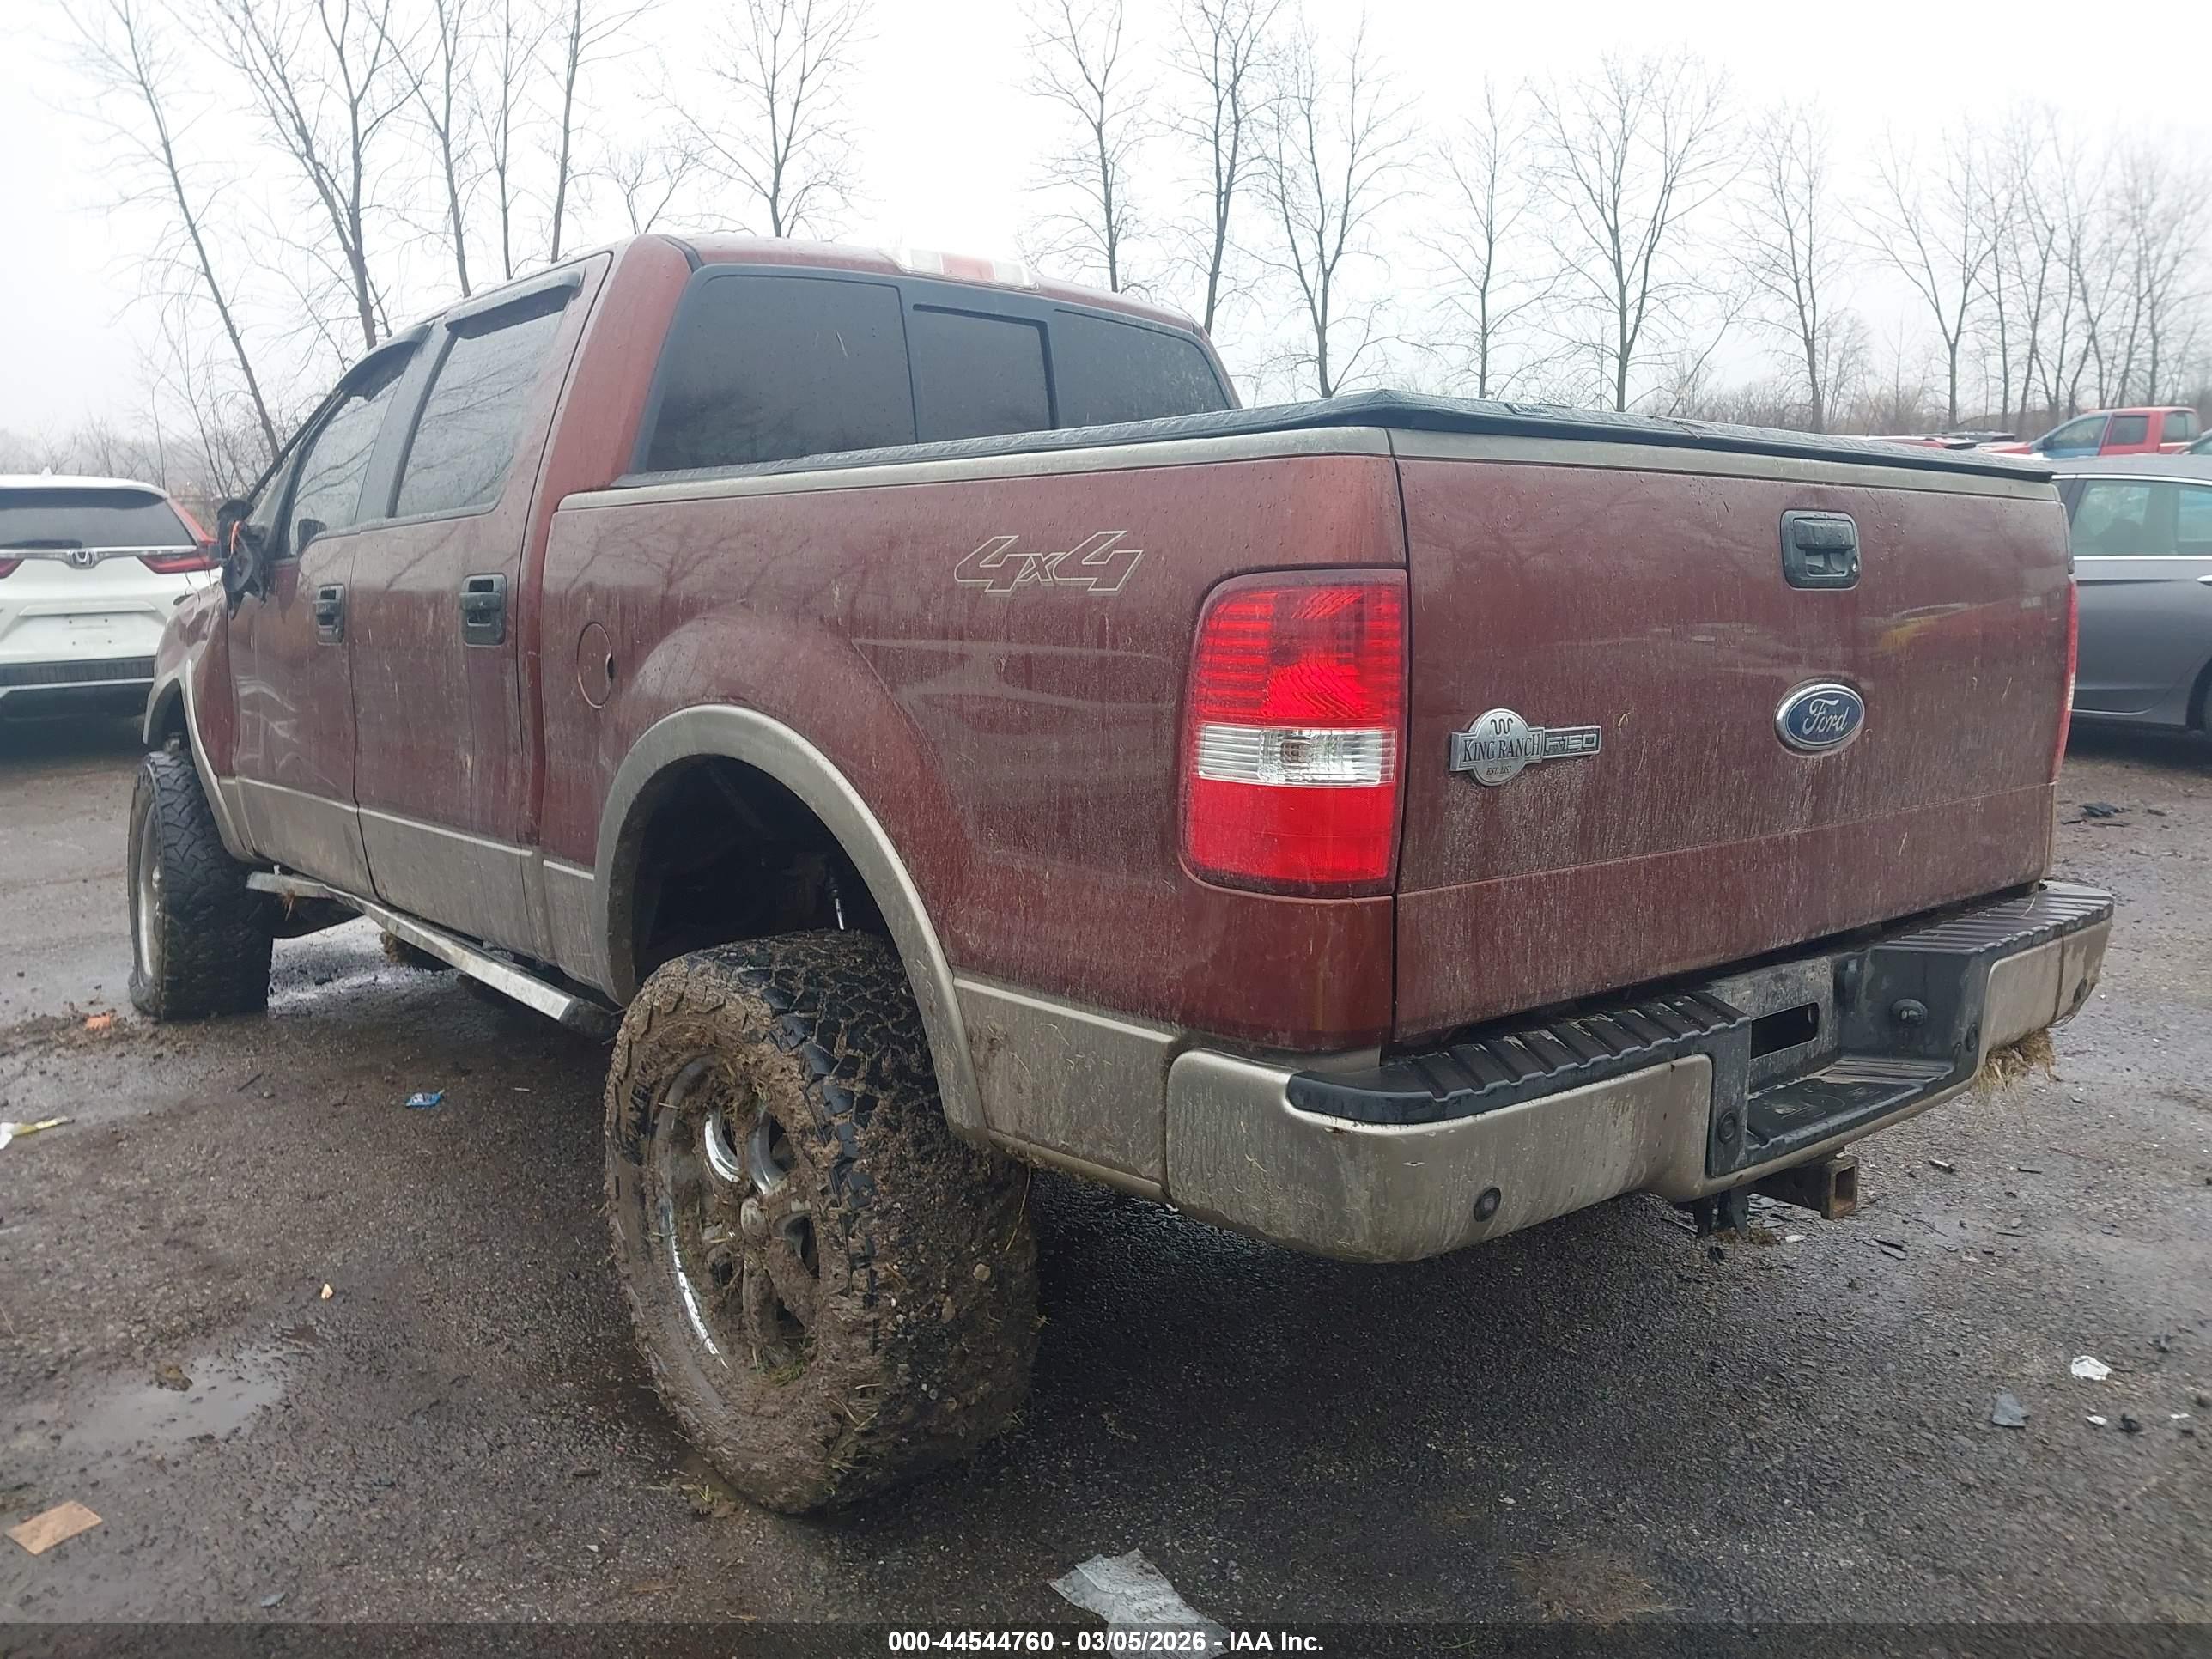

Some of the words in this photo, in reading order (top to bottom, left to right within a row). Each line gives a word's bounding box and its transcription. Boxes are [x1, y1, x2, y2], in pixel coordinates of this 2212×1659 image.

[954, 530, 1144, 594] 4x4
[1802, 698, 1850, 735] Ford
[1462, 738, 1496, 763] KING
[1497, 733, 1541, 759] RANCH
